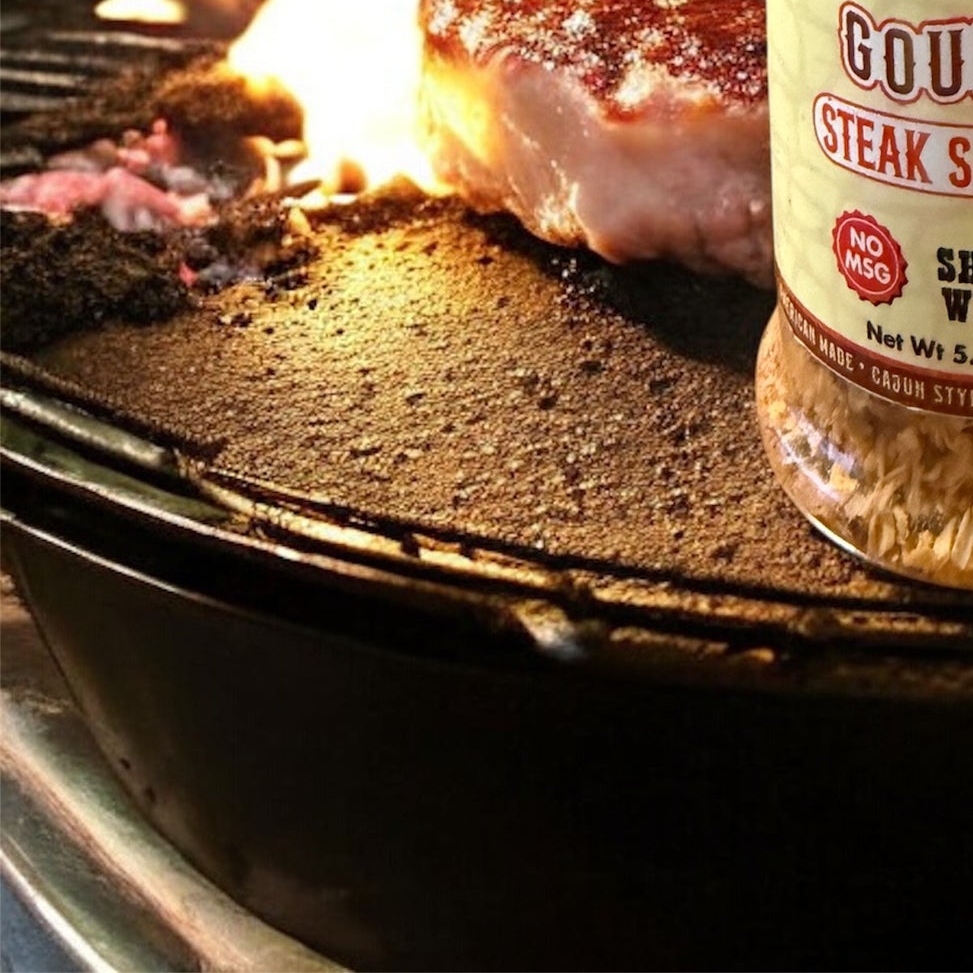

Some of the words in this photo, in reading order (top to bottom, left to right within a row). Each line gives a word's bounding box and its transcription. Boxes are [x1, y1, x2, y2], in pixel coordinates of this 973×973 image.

[821, 101, 932, 184] STEAK
[850, 227, 883, 258] NO
[845, 249, 891, 285] MSG
[866, 320, 903, 352] Net
[911, 335, 945, 361] Wt
[819, 333, 854, 371] MADE
[871, 366, 925, 400] CAJUN
